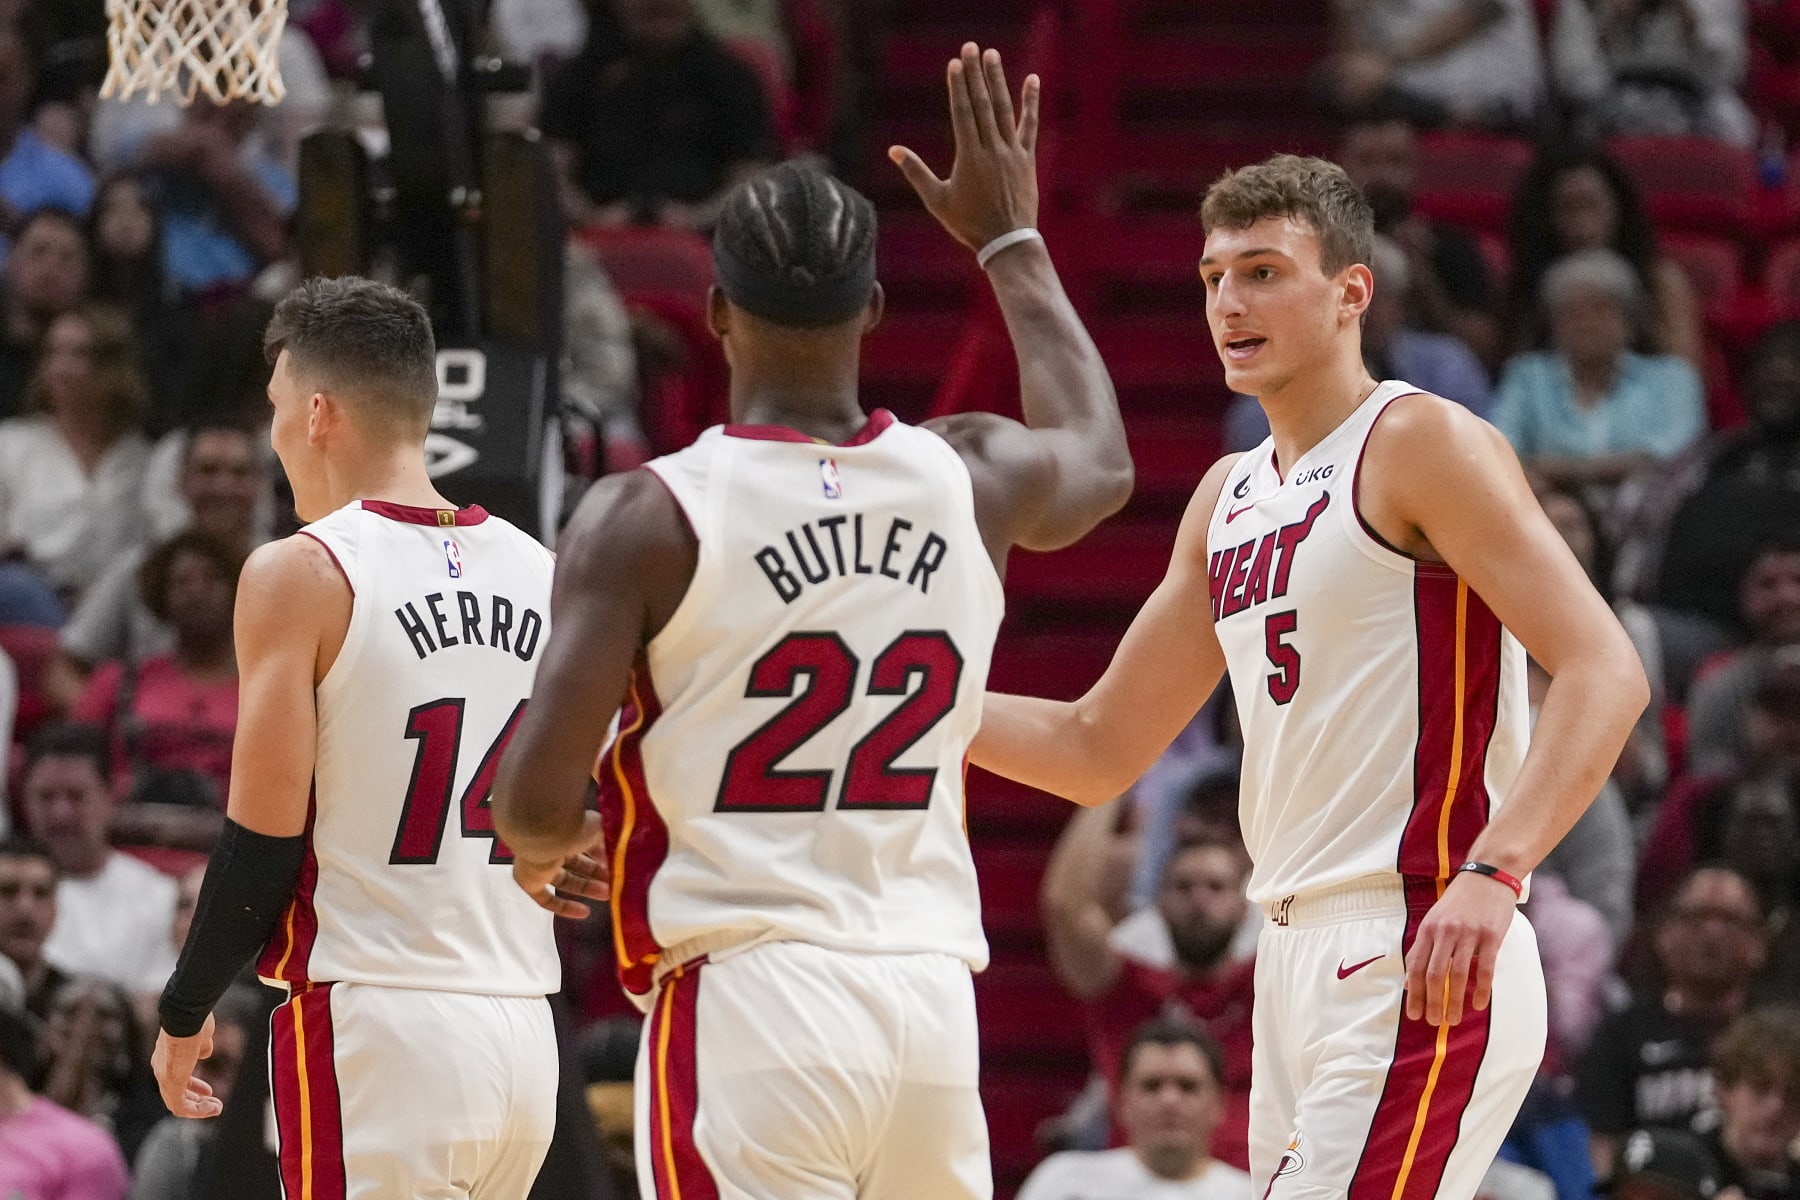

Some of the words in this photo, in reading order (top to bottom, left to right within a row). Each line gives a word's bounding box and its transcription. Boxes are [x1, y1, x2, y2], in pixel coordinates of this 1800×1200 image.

[1296, 464, 1334, 486] UKG
[754, 513, 948, 605] BUTLER
[1208, 489, 1331, 624] HEAT
[395, 591, 542, 662] HERRO
[1265, 609, 1301, 706] 5
[713, 630, 964, 812] 22
